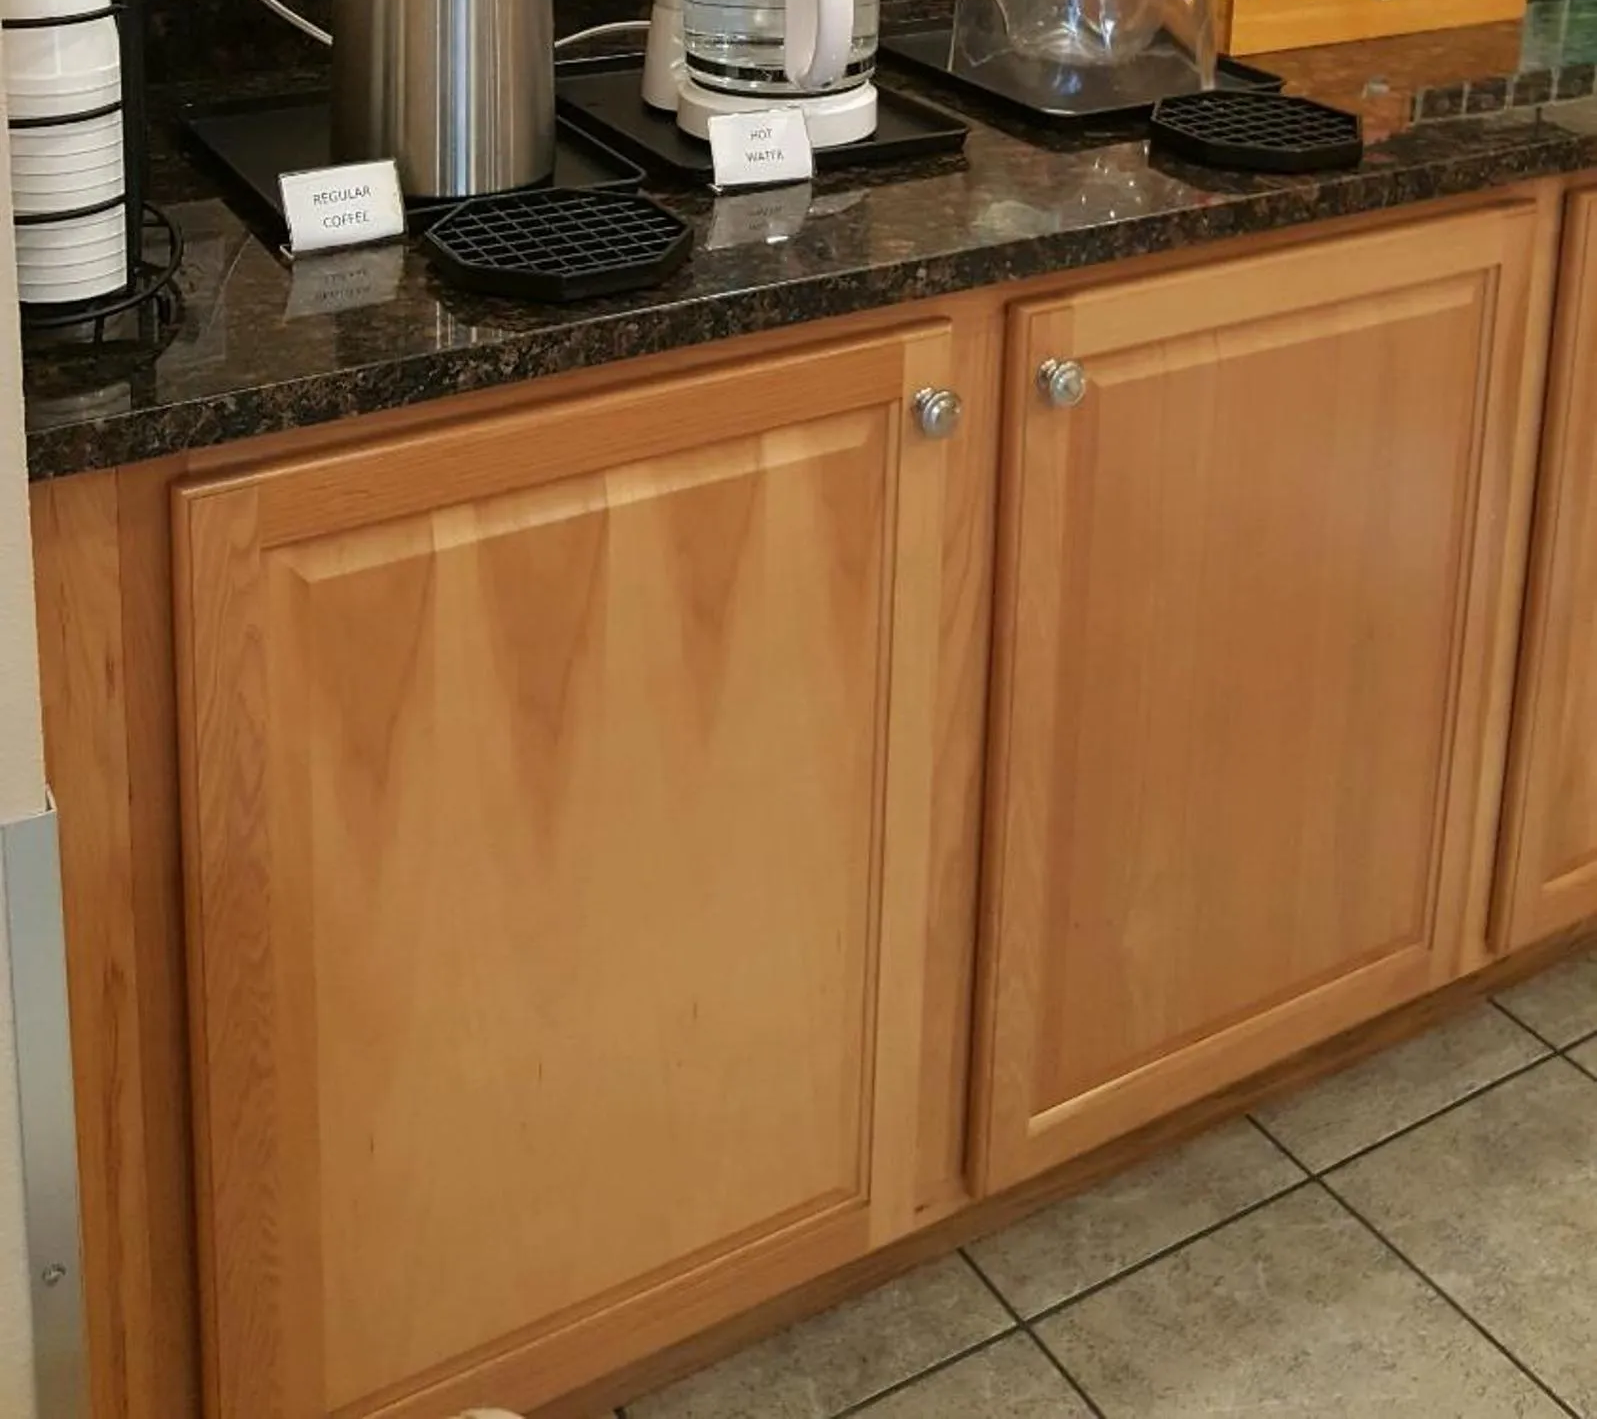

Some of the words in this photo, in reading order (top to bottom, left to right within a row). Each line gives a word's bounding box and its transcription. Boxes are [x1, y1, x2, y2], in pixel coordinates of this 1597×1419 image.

[750, 128, 773, 141] HOT
[313, 184, 372, 206] REGULAR
[322, 211, 370, 228] COFFEE
